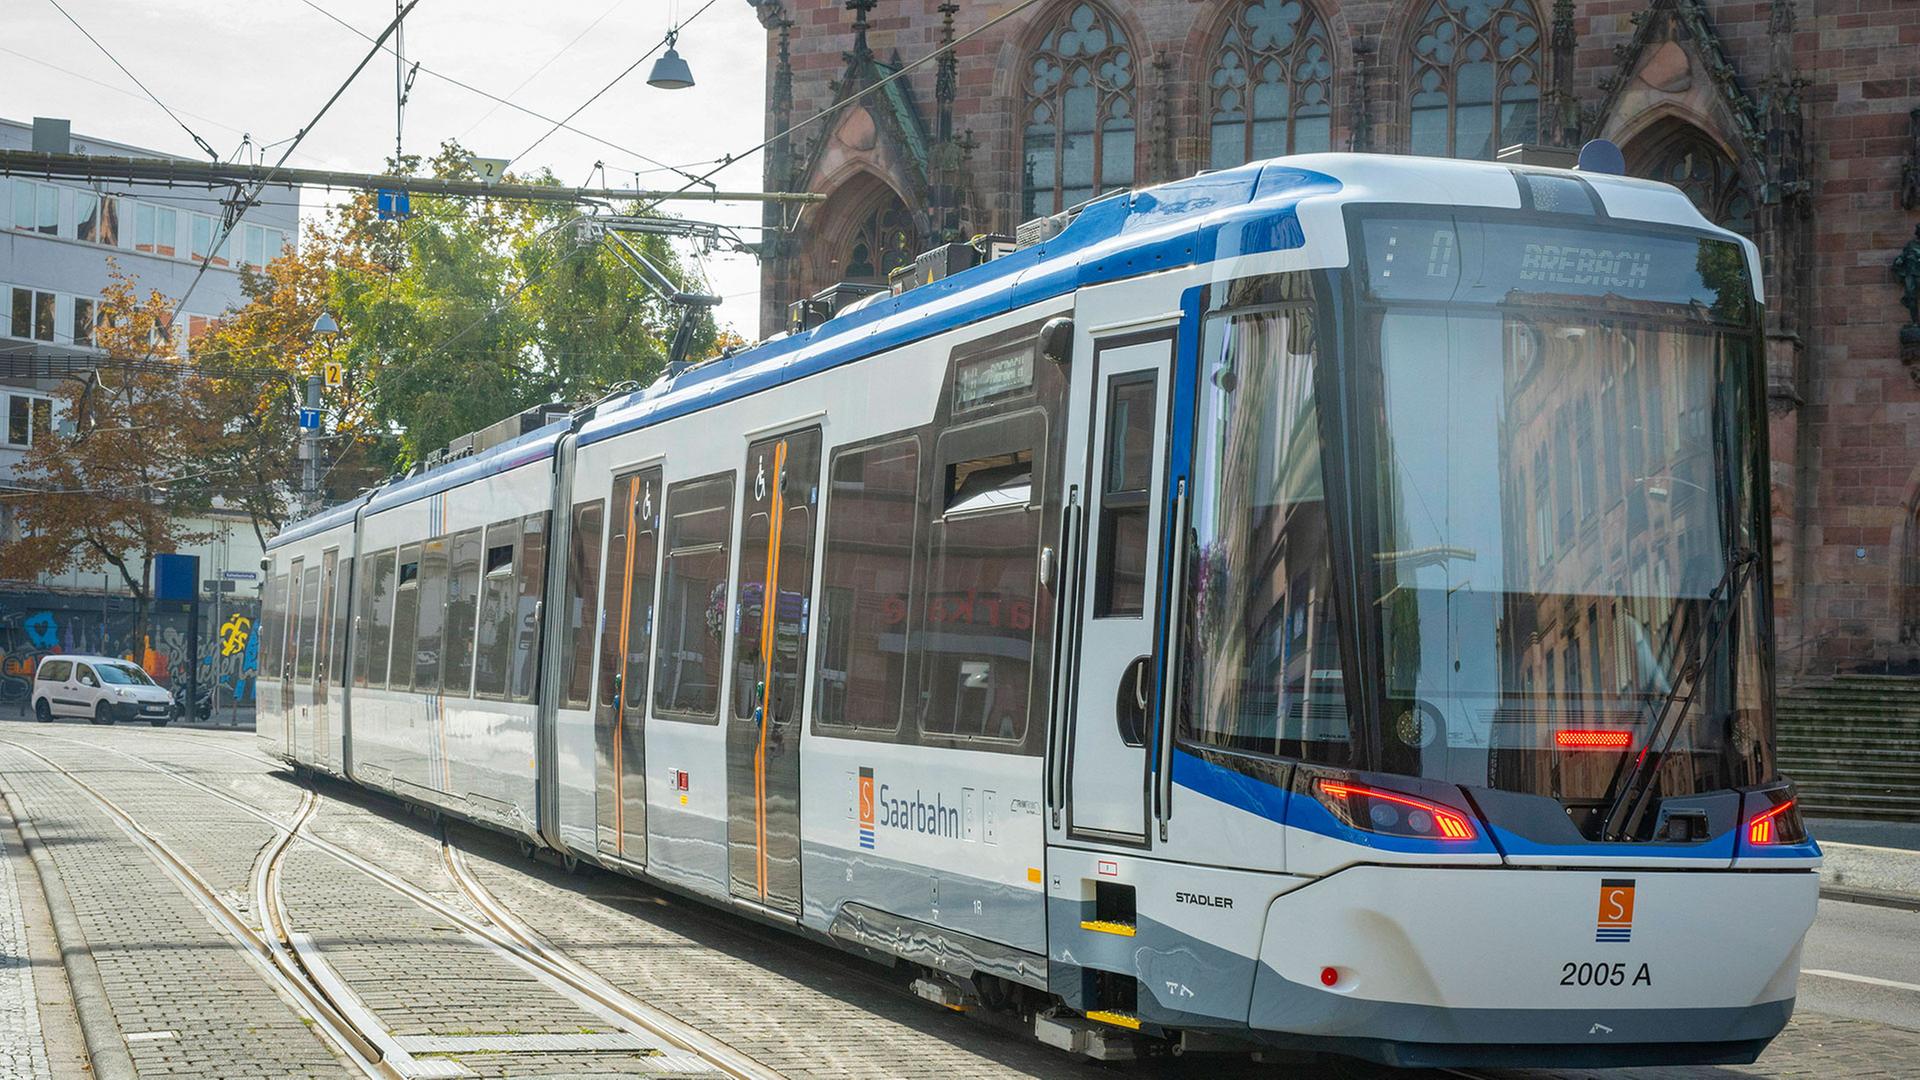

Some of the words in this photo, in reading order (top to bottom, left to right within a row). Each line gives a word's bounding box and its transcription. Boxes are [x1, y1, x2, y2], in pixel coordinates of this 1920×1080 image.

[484, 163, 494, 177] 2
[385, 193, 406, 214] T
[1519, 243, 1651, 289] BREBACH
[329, 365, 338, 383] 2
[305, 411, 316, 427] T
[879, 784, 960, 840] Saarbahn
[972, 900, 983, 916] 1R
[1175, 891, 1233, 909] STADLER
[1608, 890, 1625, 920] S
[1560, 962, 1626, 987] 2005
[1631, 962, 1652, 987] A
